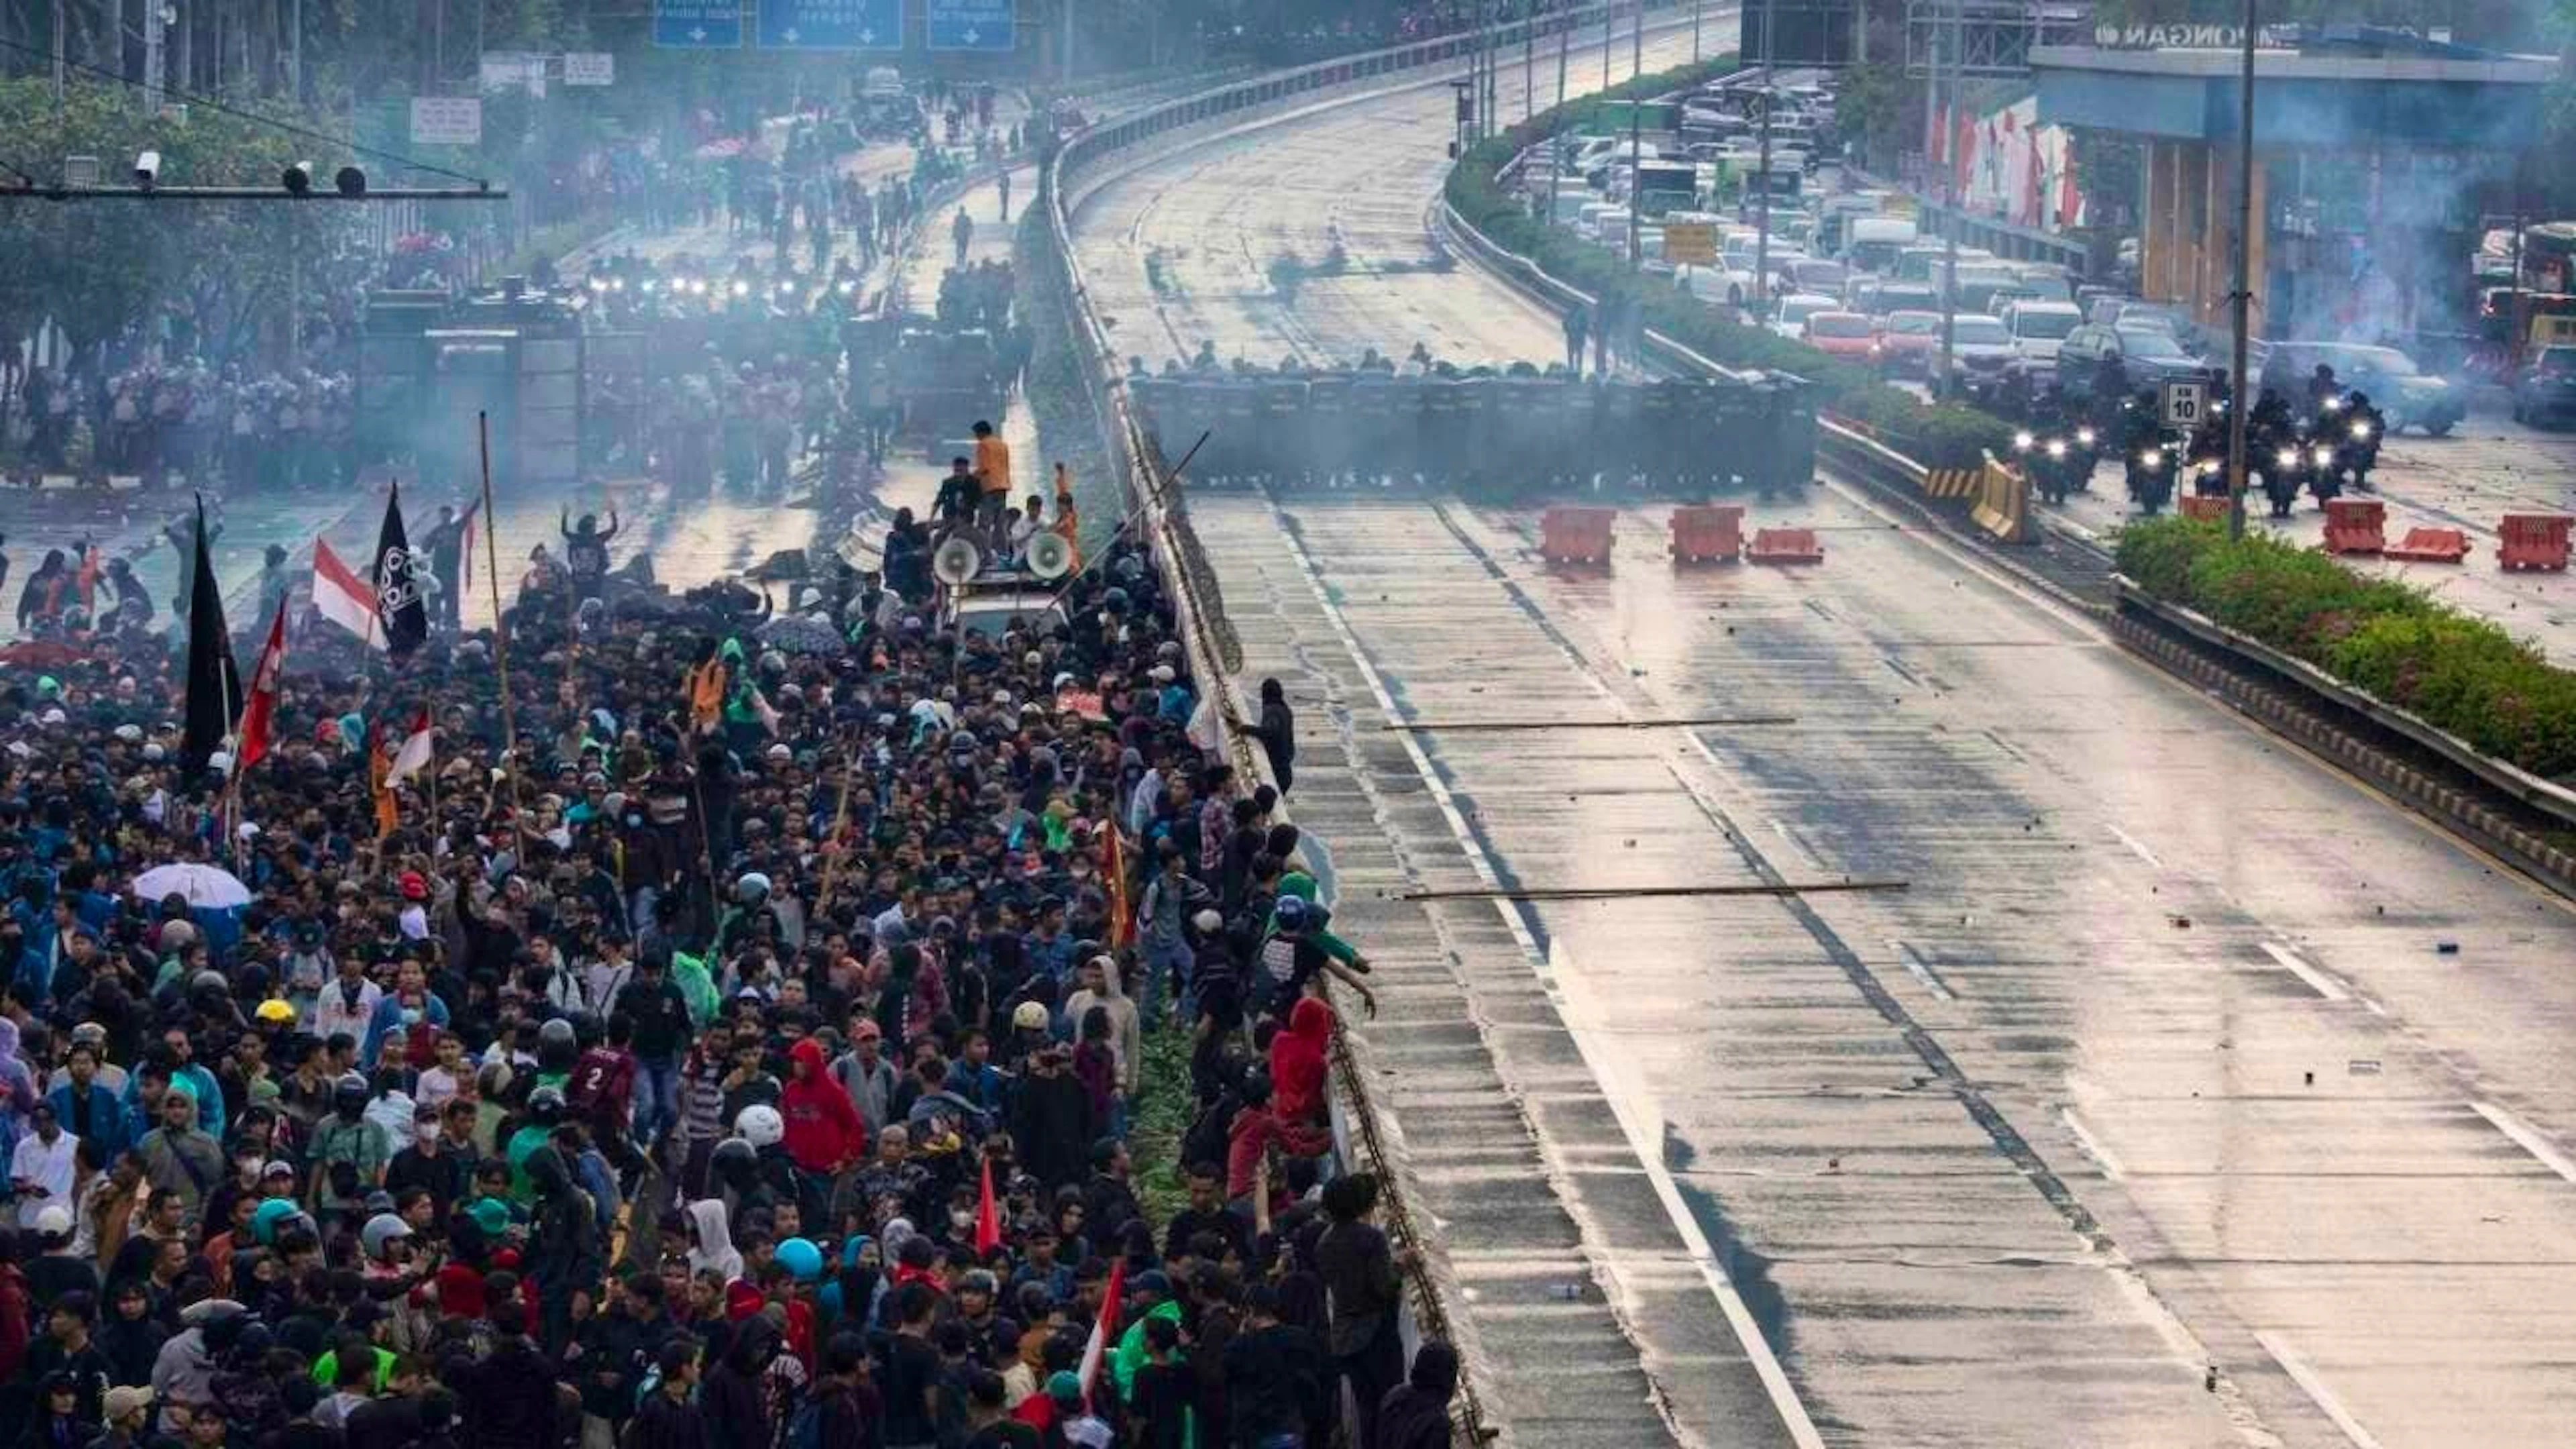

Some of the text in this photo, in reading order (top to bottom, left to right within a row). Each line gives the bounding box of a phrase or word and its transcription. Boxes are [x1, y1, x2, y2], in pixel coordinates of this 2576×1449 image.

[2178, 387, 2192, 396] KM
[2174, 401, 2194, 417] 10
[586, 1067, 602, 1090] 2
